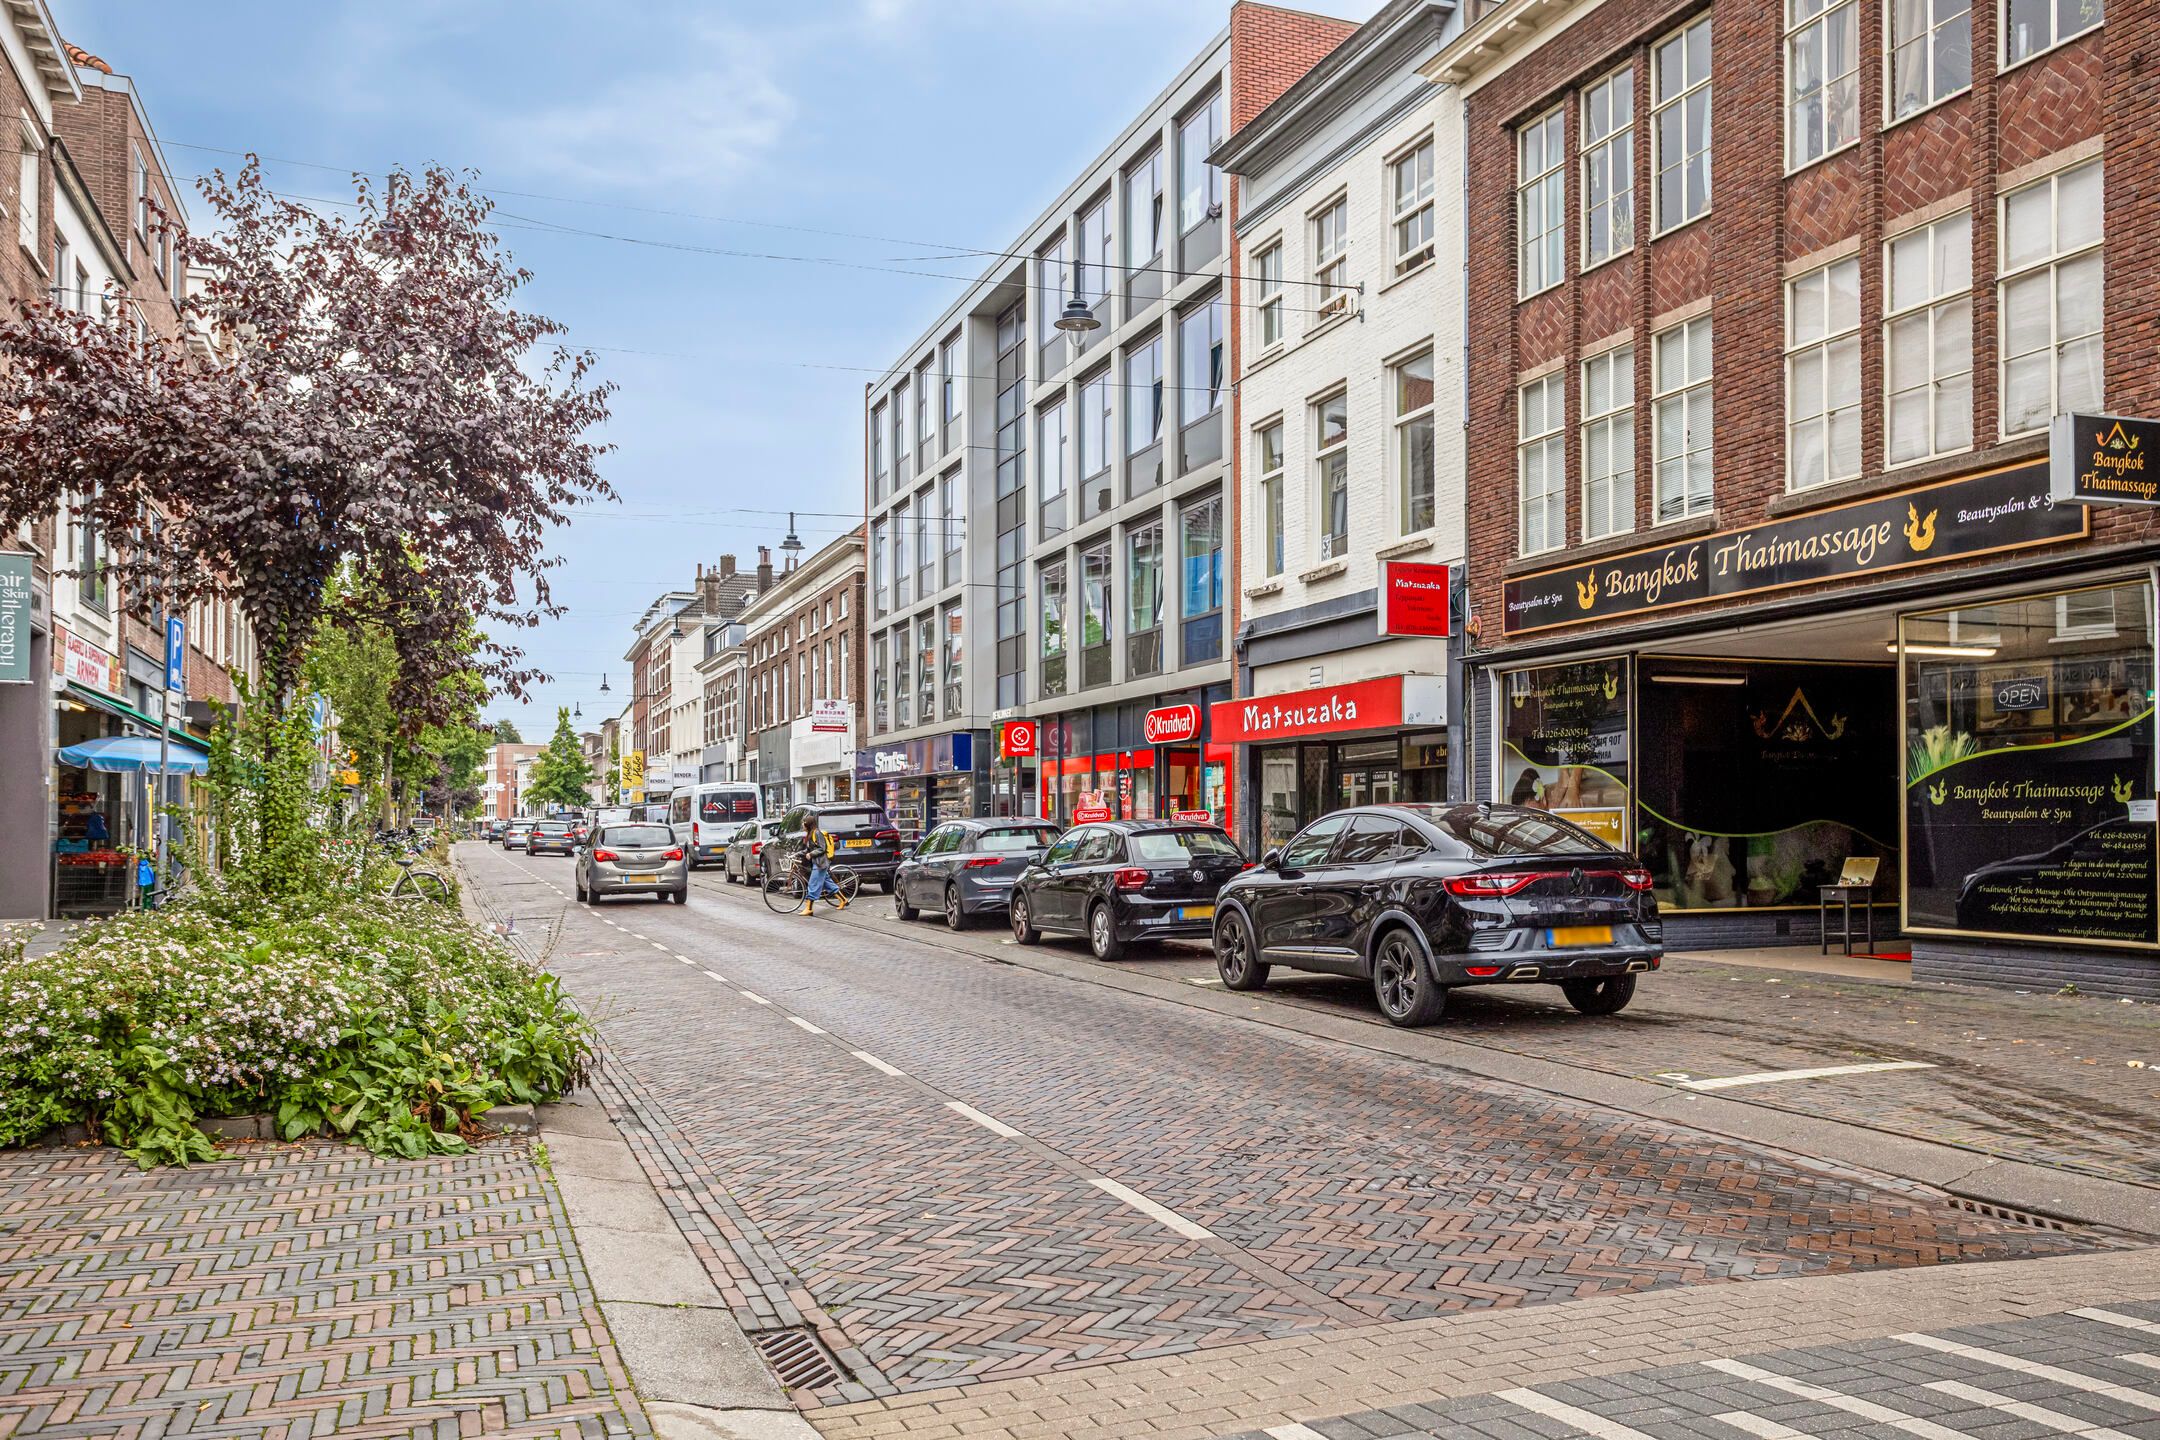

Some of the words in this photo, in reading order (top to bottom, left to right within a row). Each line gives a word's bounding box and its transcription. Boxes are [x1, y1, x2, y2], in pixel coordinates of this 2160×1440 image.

[2093, 451, 2145, 476] Bangkok
[2081, 470, 2158, 500] Thaimassage
[1957, 497, 2025, 523] Beautysalon
[2028, 496, 2041, 509] &
[1605, 546, 1700, 604] Bangkok
[1714, 519, 1892, 577] Thaimassage
[1395, 579, 1441, 590] Matsuzaka
[2, 588, 29, 600] Skin
[1508, 595, 1543, 613] Beautysalon
[1543, 595, 1551, 605] &
[1551, 593, 1563, 607] Spa
[174, 623, 181, 660] P
[1998, 686, 2041, 705] OPEN
[1243, 694, 1357, 732] Matsuzaka
[1156, 713, 1191, 735] Kruidvat
[1545, 728, 1589, 739] 026-8200514
[1954, 781, 2009, 806] Bangkok
[2013, 780, 2105, 804] Thaimassage
[1083, 811, 1105, 819] Kruidvat
[1180, 812, 1208, 822] Kruidvat
[1981, 807, 2038, 823] Beautysalon
[2041, 808, 2051, 818] &
[2053, 807, 2072, 823] Spa
[2102, 831, 2147, 840] 026-8200514
[2101, 841, 2147, 850] 06-48441595
[2068, 859, 2086, 870] dagen
[2120, 860, 2148, 872] geopend
[2035, 887, 2060, 898] Massage
[2118, 900, 2148, 912] Massage
[2095, 909, 2122, 920] Massage
